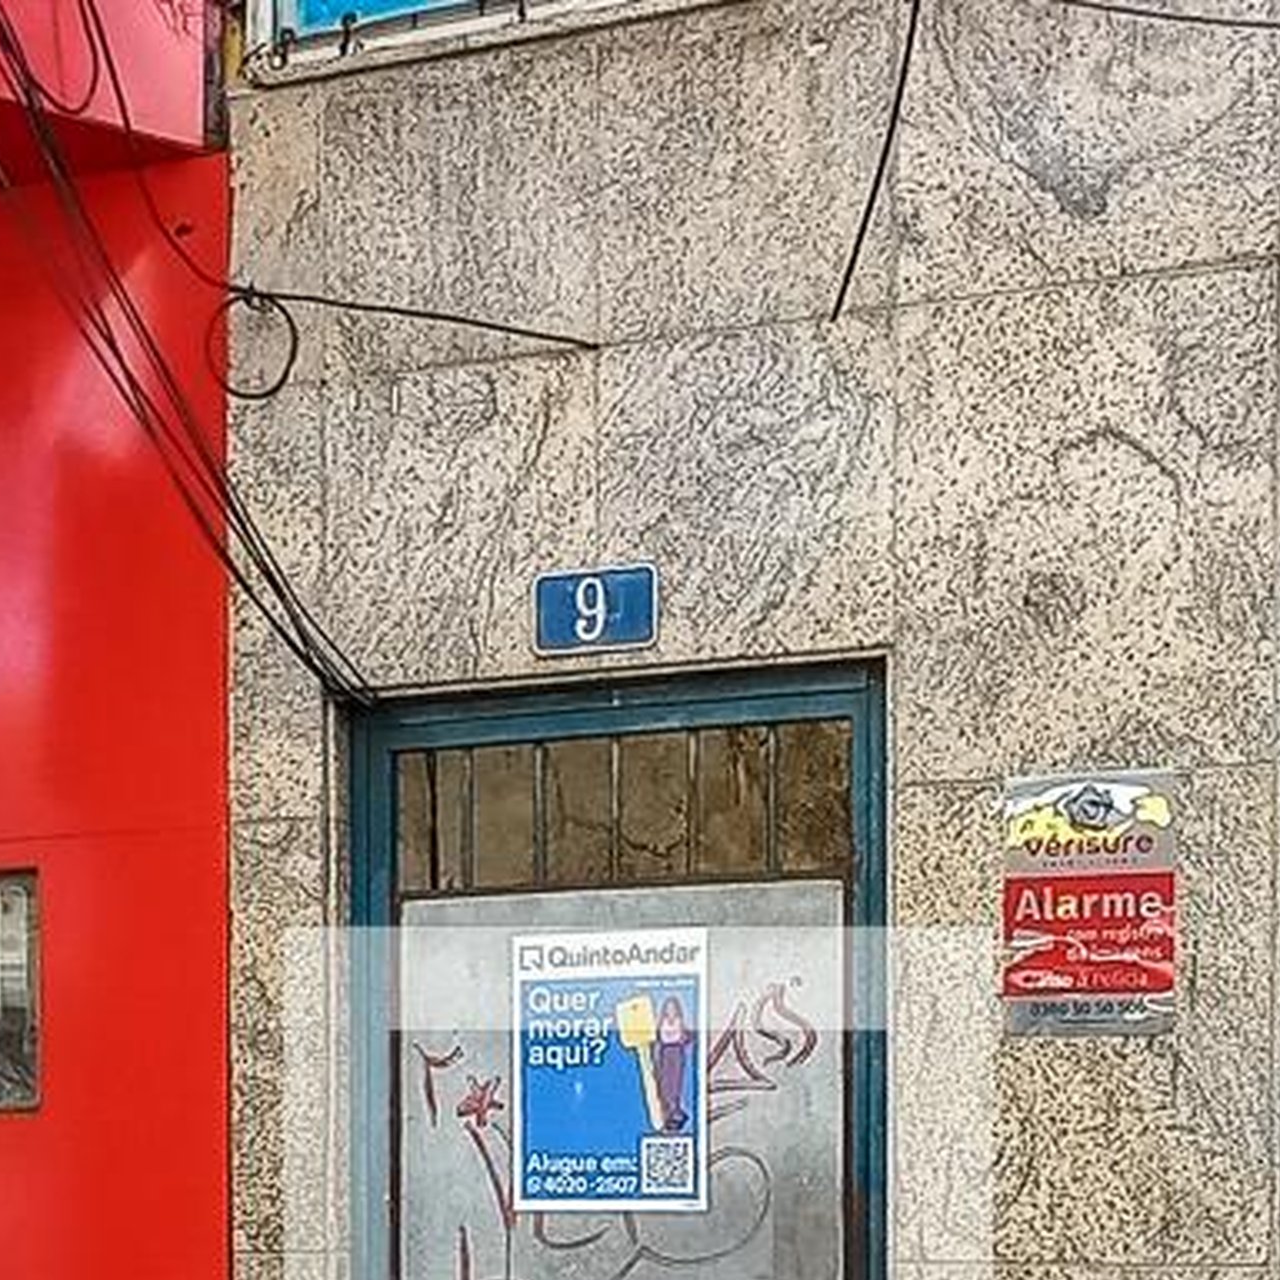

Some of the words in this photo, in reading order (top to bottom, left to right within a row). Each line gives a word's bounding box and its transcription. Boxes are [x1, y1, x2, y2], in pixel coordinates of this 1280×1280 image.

[576, 577, 604, 640] 9
[1015, 887, 1163, 921] Alarme
[547, 943, 701, 968] QuintoAndar
[529, 986, 601, 1014] Quer
[529, 1017, 614, 1040] morar
[528, 1037, 607, 1070] aqui?
[526, 1153, 598, 1178] Alugue
